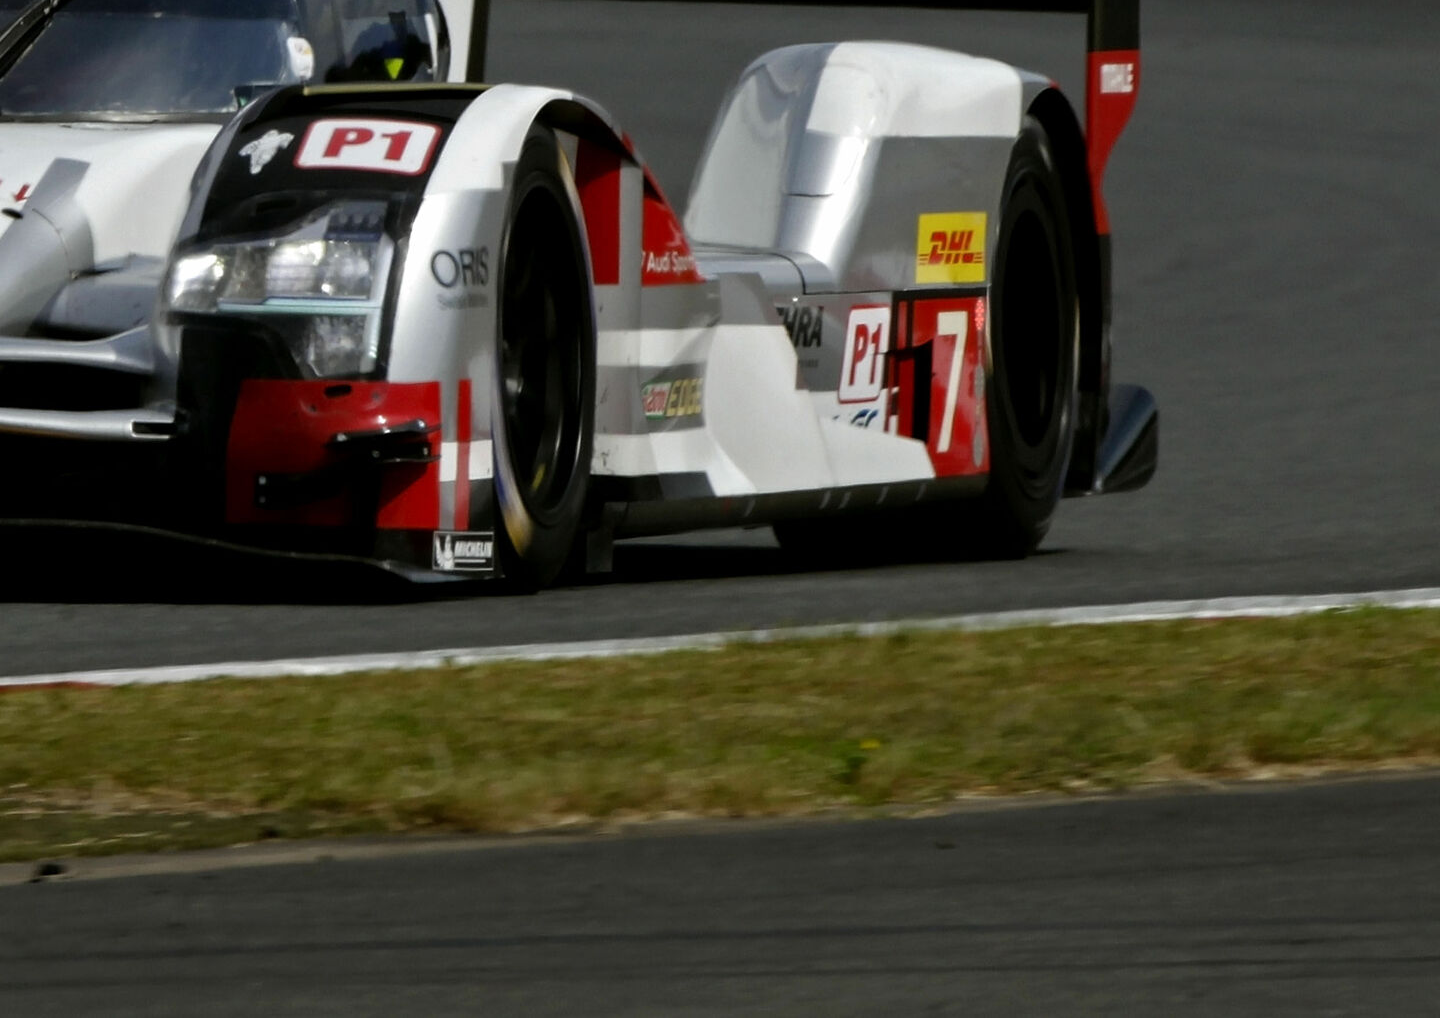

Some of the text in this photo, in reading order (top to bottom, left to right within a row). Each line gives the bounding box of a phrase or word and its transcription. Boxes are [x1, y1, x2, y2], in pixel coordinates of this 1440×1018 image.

[323, 127, 413, 161] P1
[430, 246, 489, 288] ORIS
[927, 231, 976, 265] DHL
[848, 322, 883, 386] P1
[936, 310, 969, 454] 7
